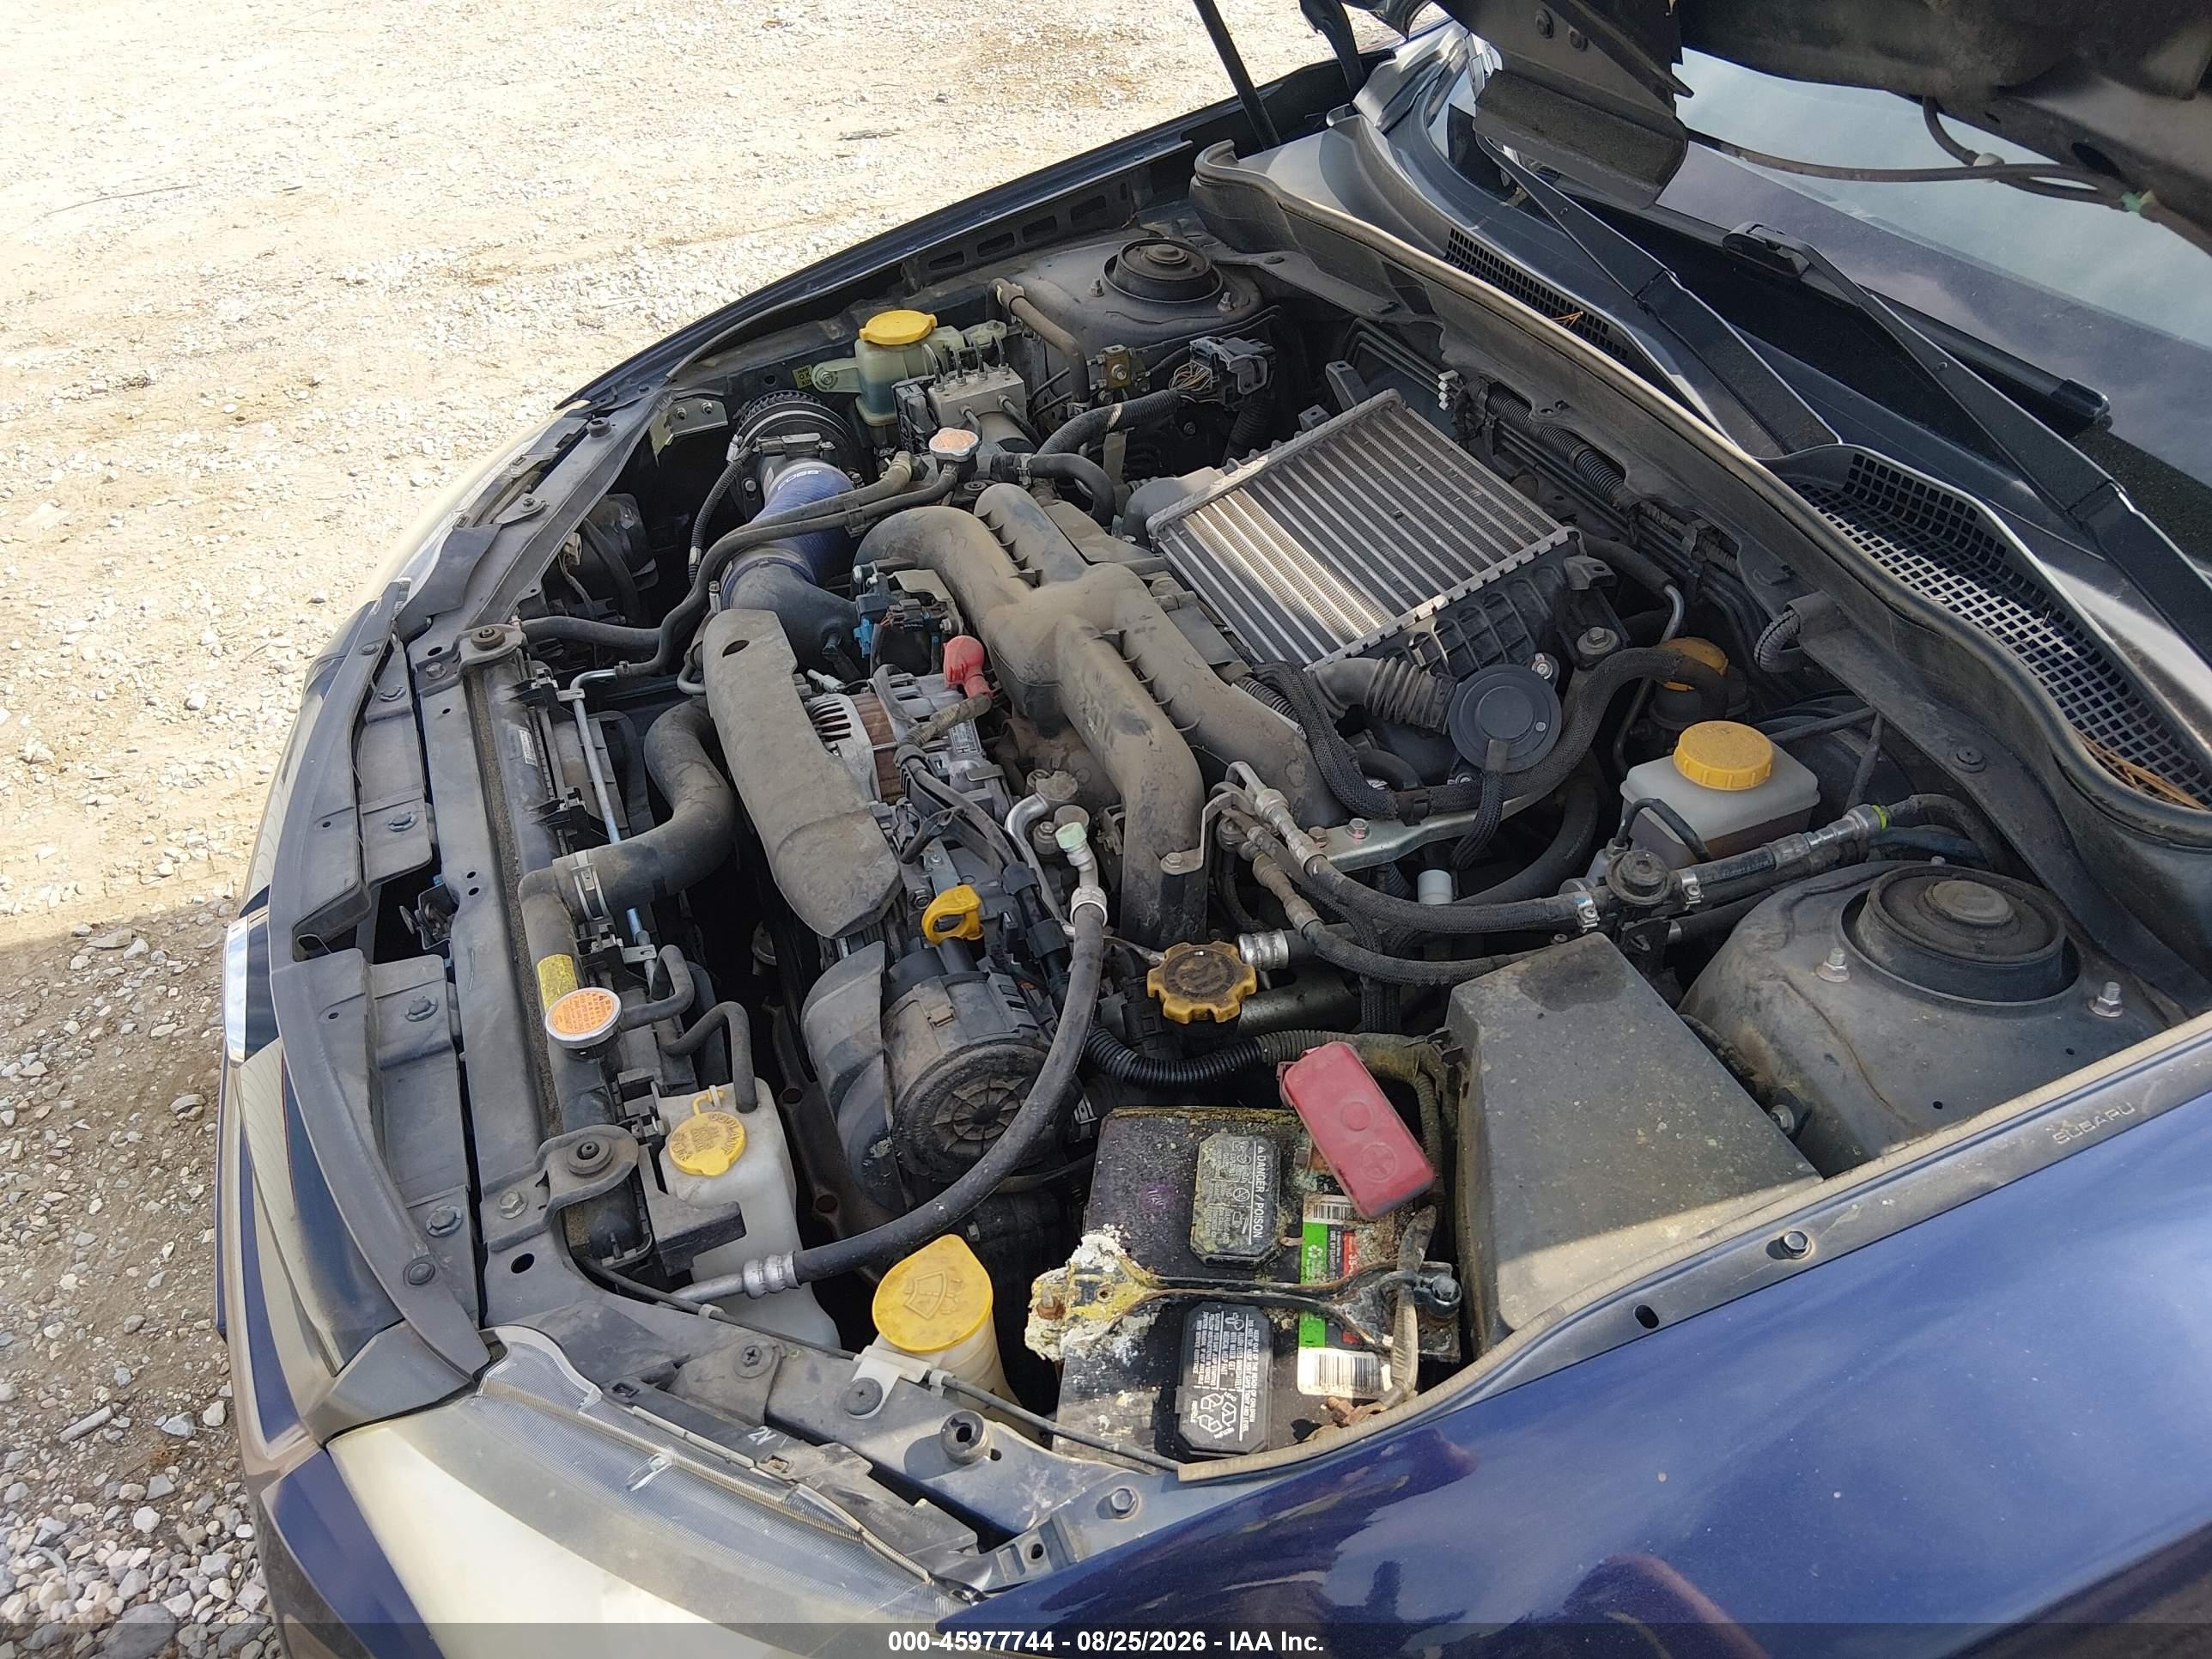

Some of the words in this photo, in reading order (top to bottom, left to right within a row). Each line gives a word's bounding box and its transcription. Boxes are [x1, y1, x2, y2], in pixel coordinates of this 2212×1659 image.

[708, 1113, 741, 1156] COOLANT
[2051, 1102, 2136, 1145] SUBARU
[1255, 1155, 1267, 1193] DANGER
[1252, 1202, 1265, 1238] POISON
[1222, 1331, 1231, 1350] MEDICAL
